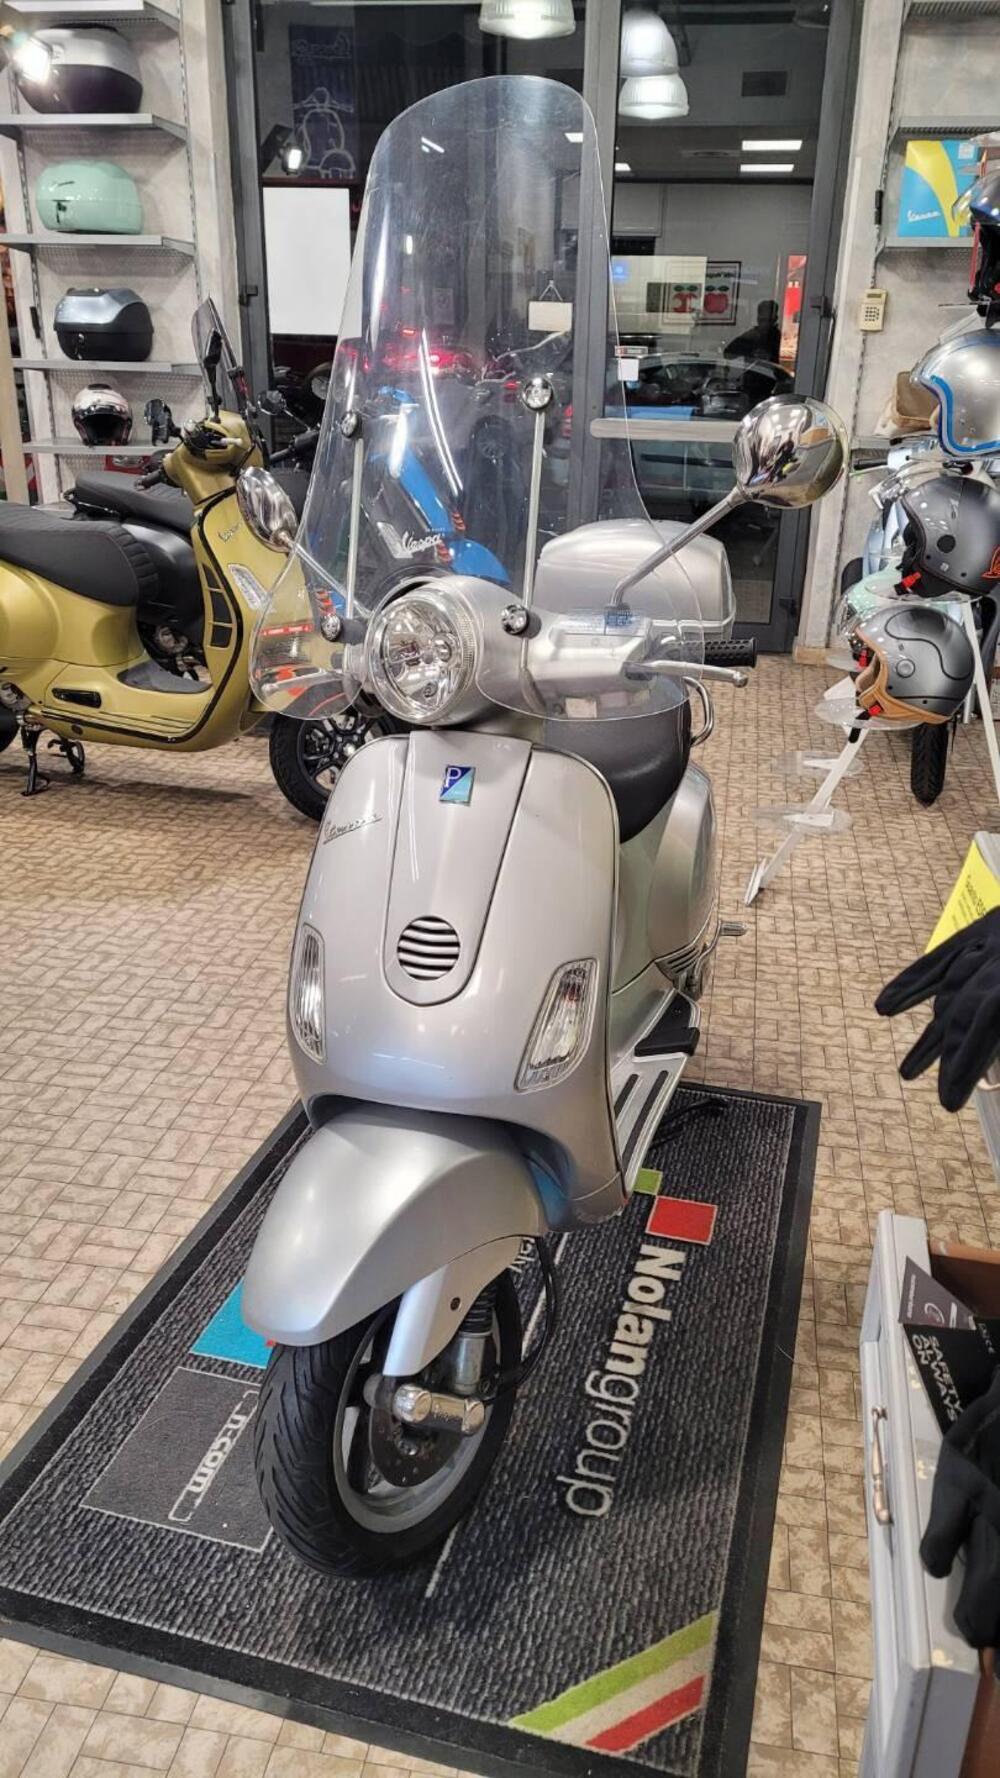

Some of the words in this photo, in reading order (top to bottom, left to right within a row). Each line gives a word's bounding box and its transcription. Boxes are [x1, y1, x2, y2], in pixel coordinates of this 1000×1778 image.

[402, 530, 443, 553] Vespa
[445, 767, 462, 788] P
[912, 1334, 929, 1365] ON
[929, 1335, 964, 1416] SAFETY
[556, 1243, 687, 1518] Nolangroup
[920, 1335, 958, 1422] ALWAYS
